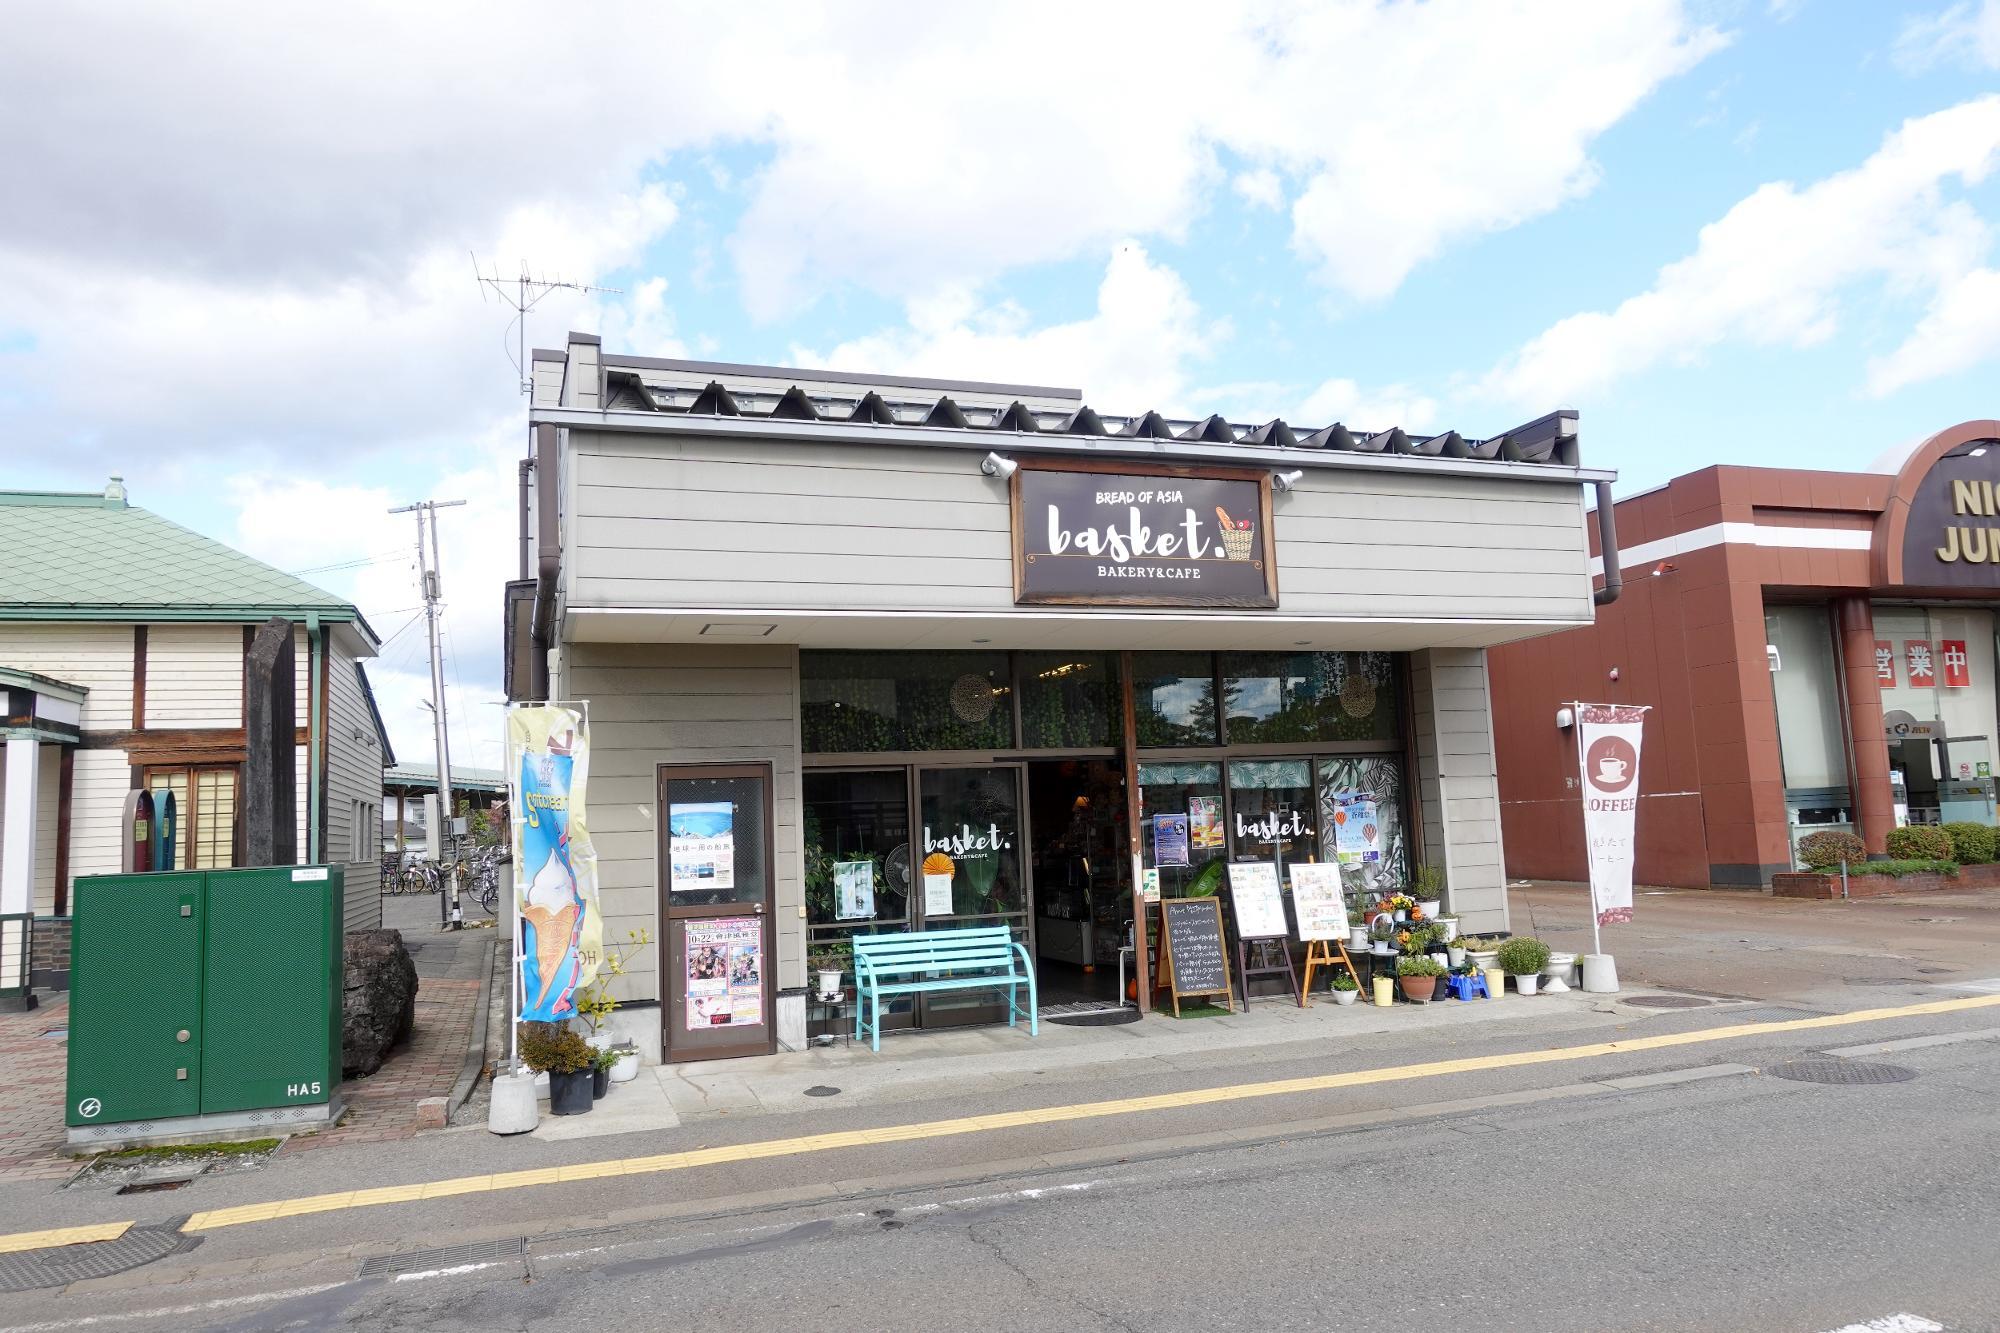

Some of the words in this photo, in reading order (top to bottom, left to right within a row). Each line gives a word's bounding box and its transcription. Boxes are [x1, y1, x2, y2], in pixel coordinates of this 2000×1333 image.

[1095, 491, 1135, 505] BREAD
[1137, 491, 1154, 504] OF
[1156, 490, 1183, 504] ASIA
[1950, 480, 2000, 516] NI
[1048, 504, 1225, 562] basket.
[1097, 565, 1201, 579] BAKERY&CAFE
[1875, 645, 1966, 679] 営業中
[1587, 798, 1635, 812] OFFEE
[924, 823, 1011, 855] basket.
[1236, 810, 1311, 840] basket.
[287, 1081, 321, 1097] HA5
